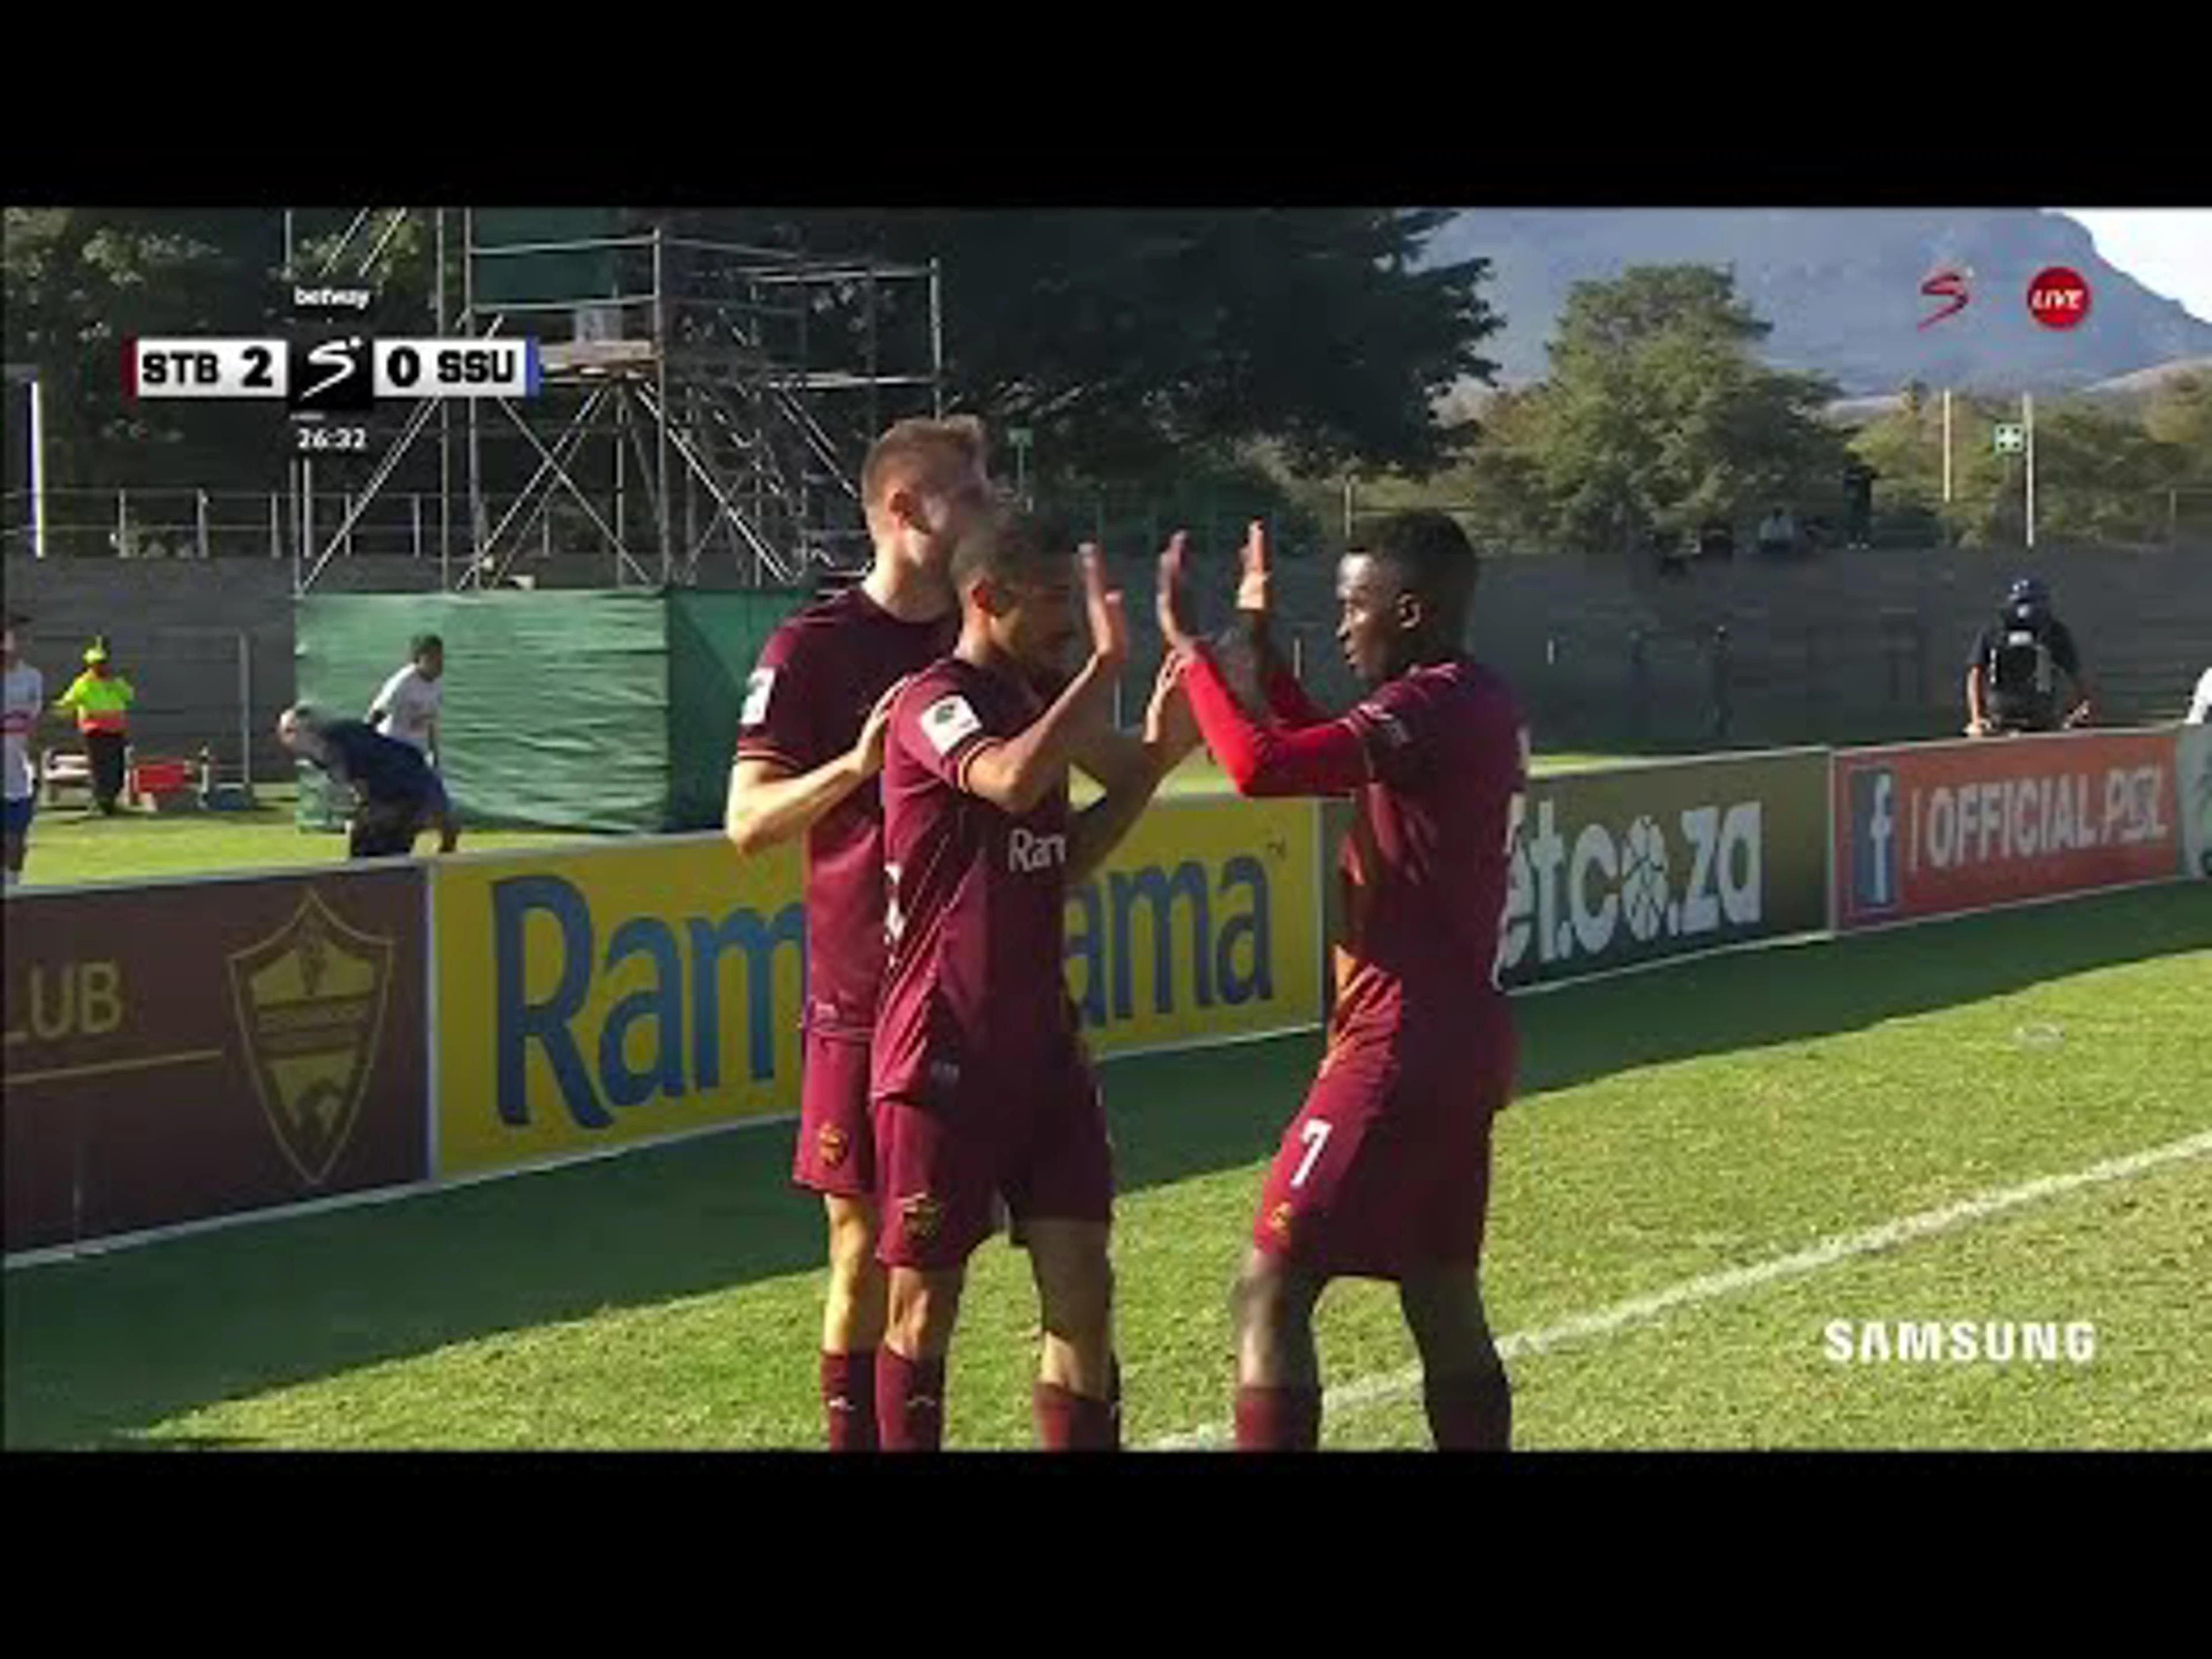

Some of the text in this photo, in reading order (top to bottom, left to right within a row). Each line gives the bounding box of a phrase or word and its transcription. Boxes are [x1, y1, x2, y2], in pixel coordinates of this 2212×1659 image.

[1927, 764, 2168, 867] OFFICIAL PSL
[1290, 1118, 1332, 1189] 7
